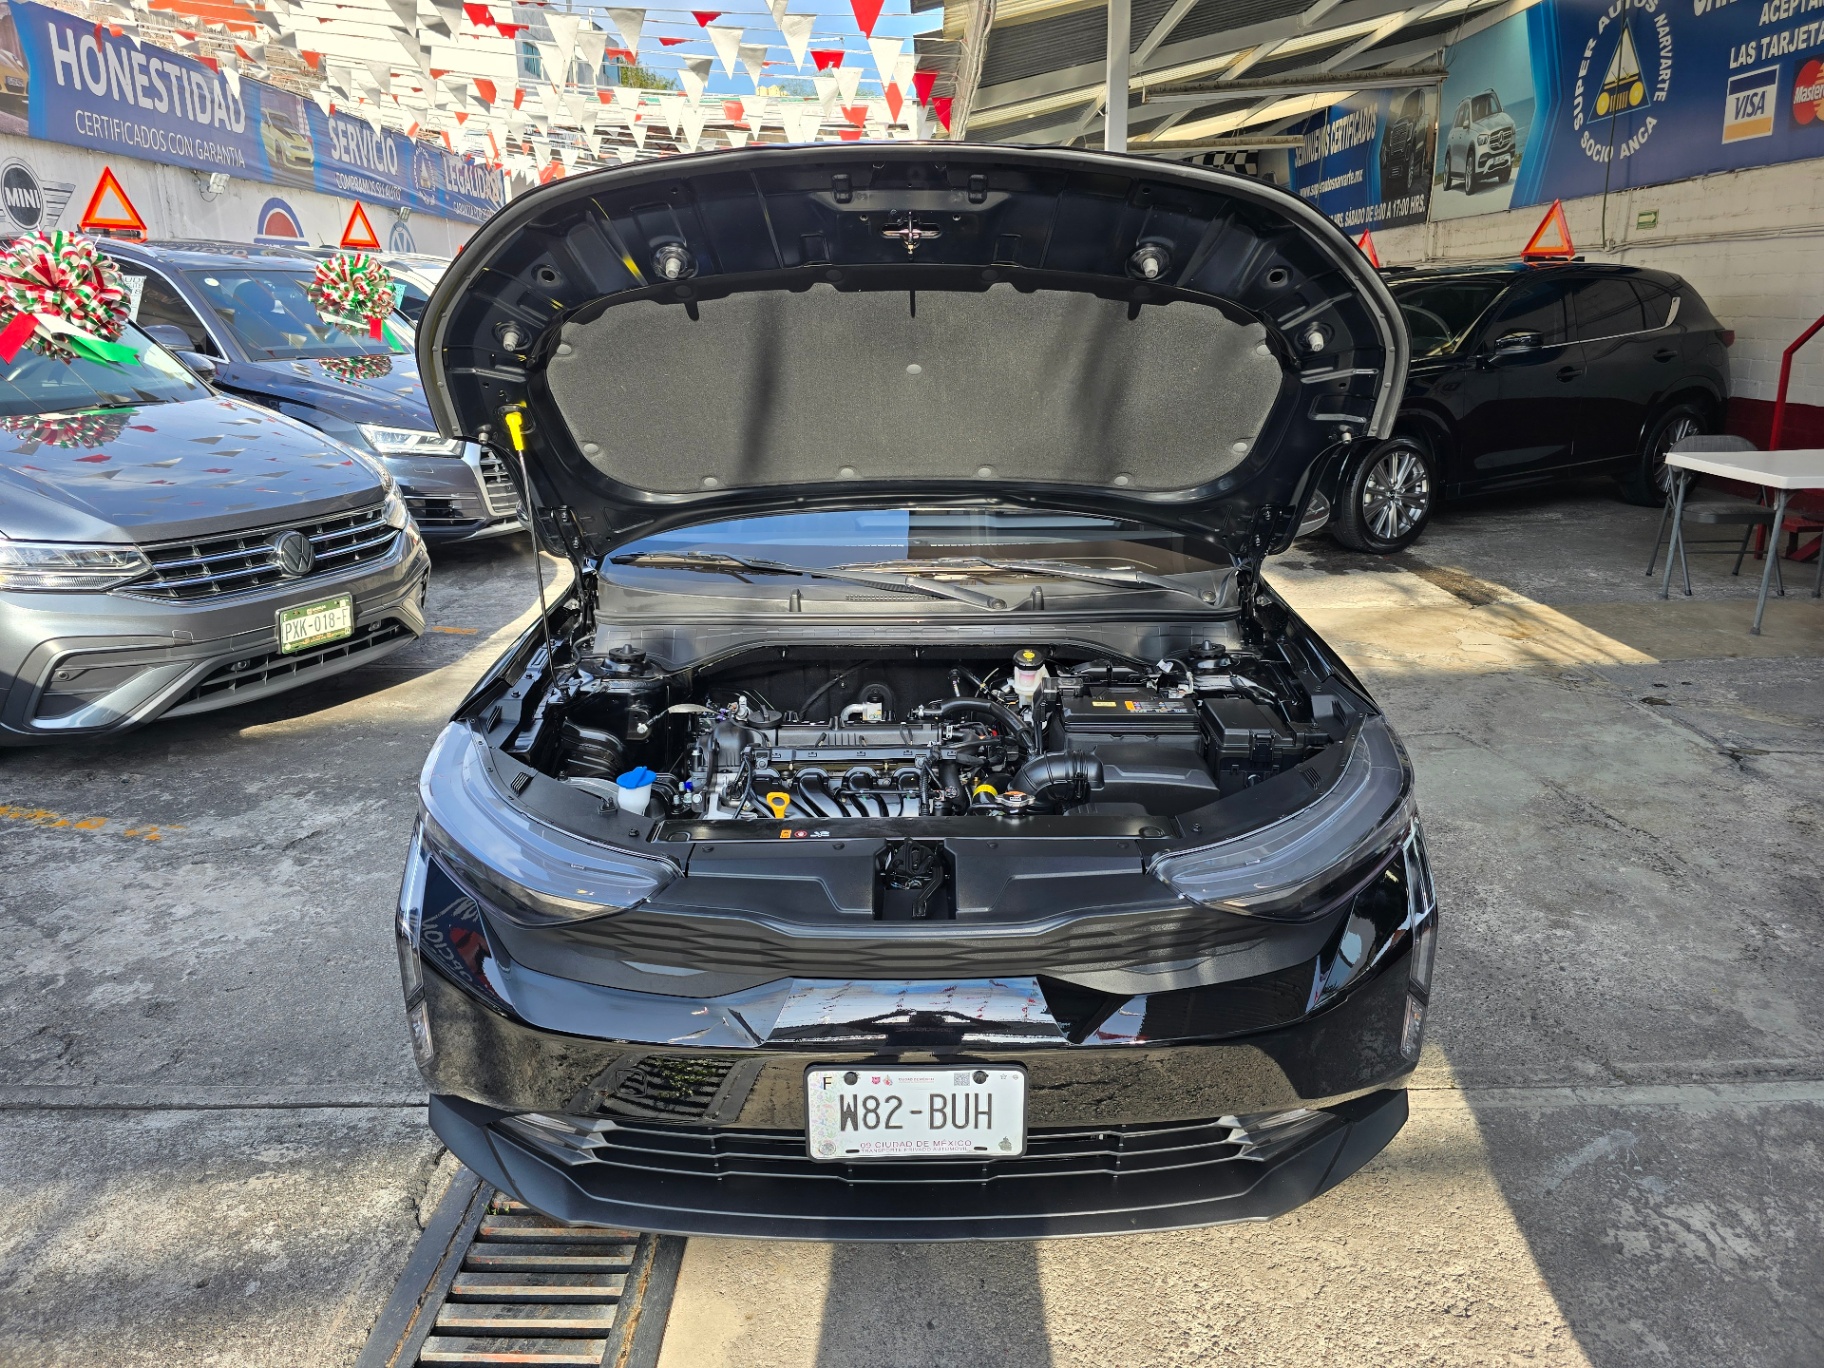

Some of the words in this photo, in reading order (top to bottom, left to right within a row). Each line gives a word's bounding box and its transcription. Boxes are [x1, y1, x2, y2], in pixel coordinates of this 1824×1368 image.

[1573, 38, 1597, 131] SUPER
[1653, 13, 1672, 102] NARVARTE
[1729, 41, 1757, 69] LAS
[48, 22, 246, 134] HONESTIDAD
[1735, 91, 1766, 120] VISA
[75, 110, 167, 152] CERTIFICADOS
[168, 132, 195, 158] CON
[195, 139, 246, 169] GARANTIA
[329, 118, 398, 176] SERVICIO
[1331, 103, 1378, 155] CERTIFICADOS
[1580, 131, 1614, 163] SOCIO
[1619, 116, 1658, 160] ANCA
[4, 186, 41, 209] MINI
[1365, 206, 1374, 223] DE
[1386, 201, 1391, 219] A
[1393, 197, 1410, 218] 17:00
[1409, 194, 1426, 214] HRS.
[285, 608, 349, 642] PXK-018-F
[823, 1076, 832, 1090] F
[839, 1093, 992, 1132] W82-BUH
[874, 1141, 913, 1149] CIUDAD
[916, 1140, 930, 1148] DE
[933, 1139, 972, 1147] MÉXICO
